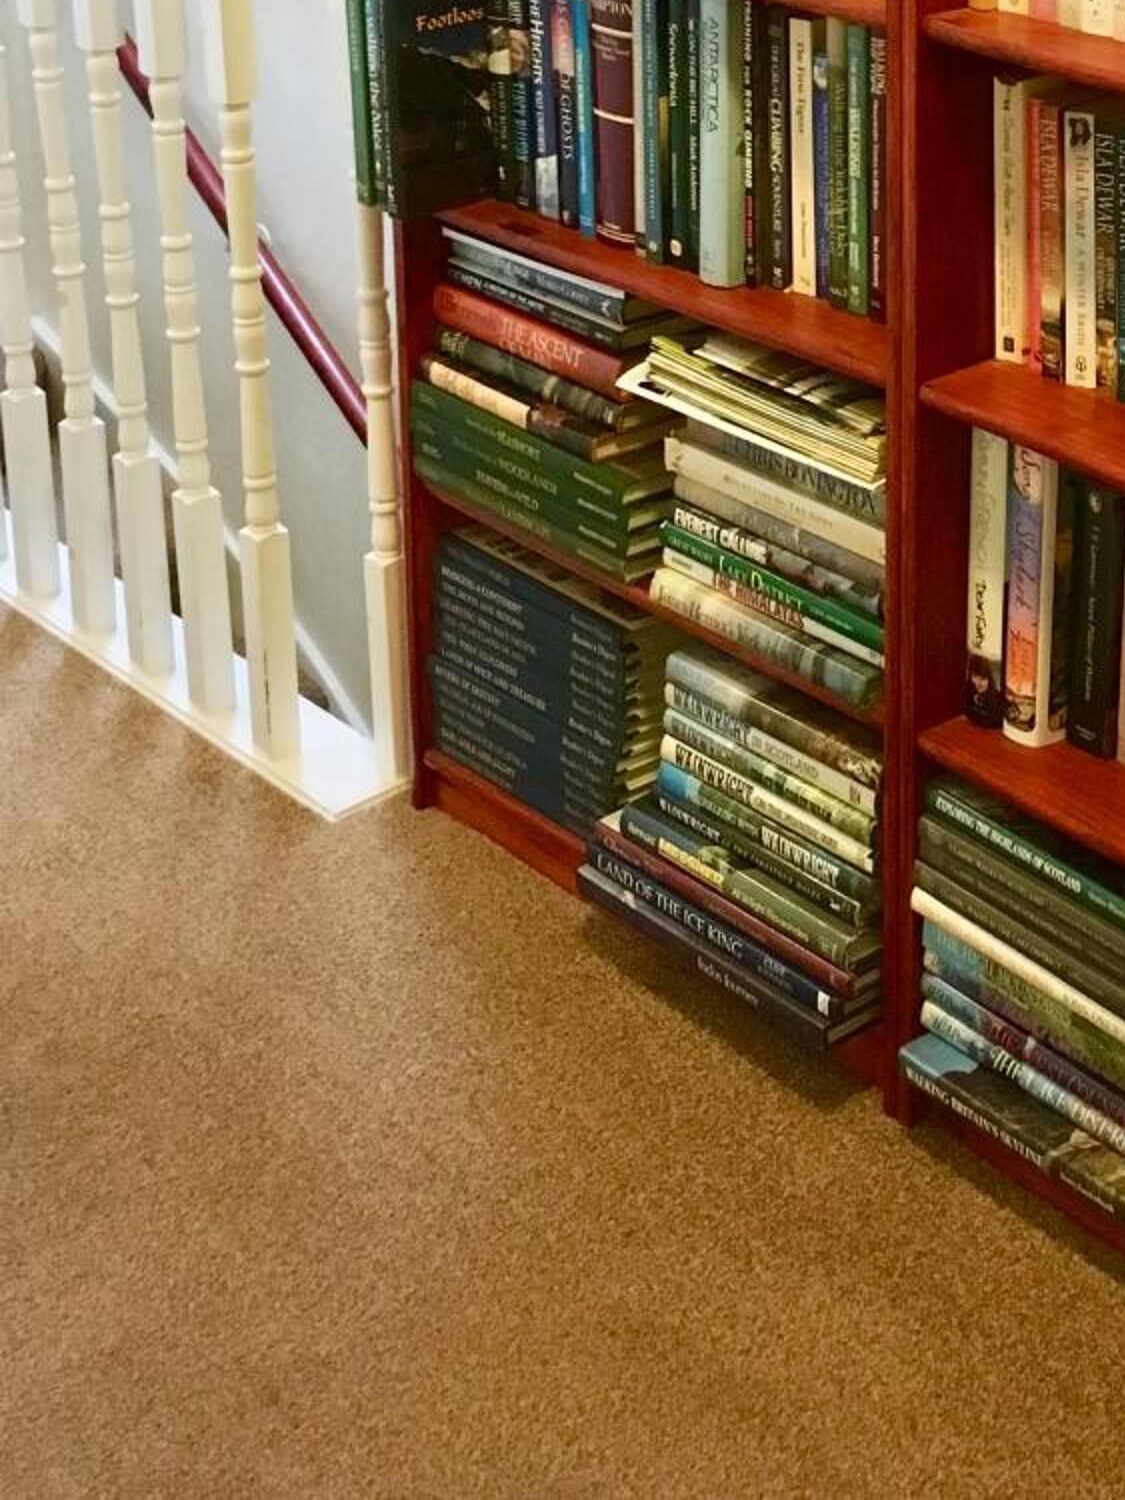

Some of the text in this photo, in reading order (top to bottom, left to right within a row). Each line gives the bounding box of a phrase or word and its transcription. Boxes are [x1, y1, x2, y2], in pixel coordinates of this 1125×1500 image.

[531, 21, 545, 84] HEIGHTS
[705, 18, 720, 133] ANTARCTICA
[560, 93, 574, 161] GHOSTS
[743, 0, 754, 188] TRAINING ROCK CLIMBING
[768, 97, 784, 173] CLIMBING
[848, 107, 862, 179] WALKING
[1041, 120, 1059, 213] ISLA DEWAR
[1074, 155, 1090, 238] Isla Dewar
[1096, 133, 1117, 234] ISLA DEWAR
[974, 581, 989, 612] Dear
[674, 742, 755, 803] WAINWRIGHT
[760, 826, 841, 888] WAINWRIGHT
[656, 884, 706, 934] THE ICE
